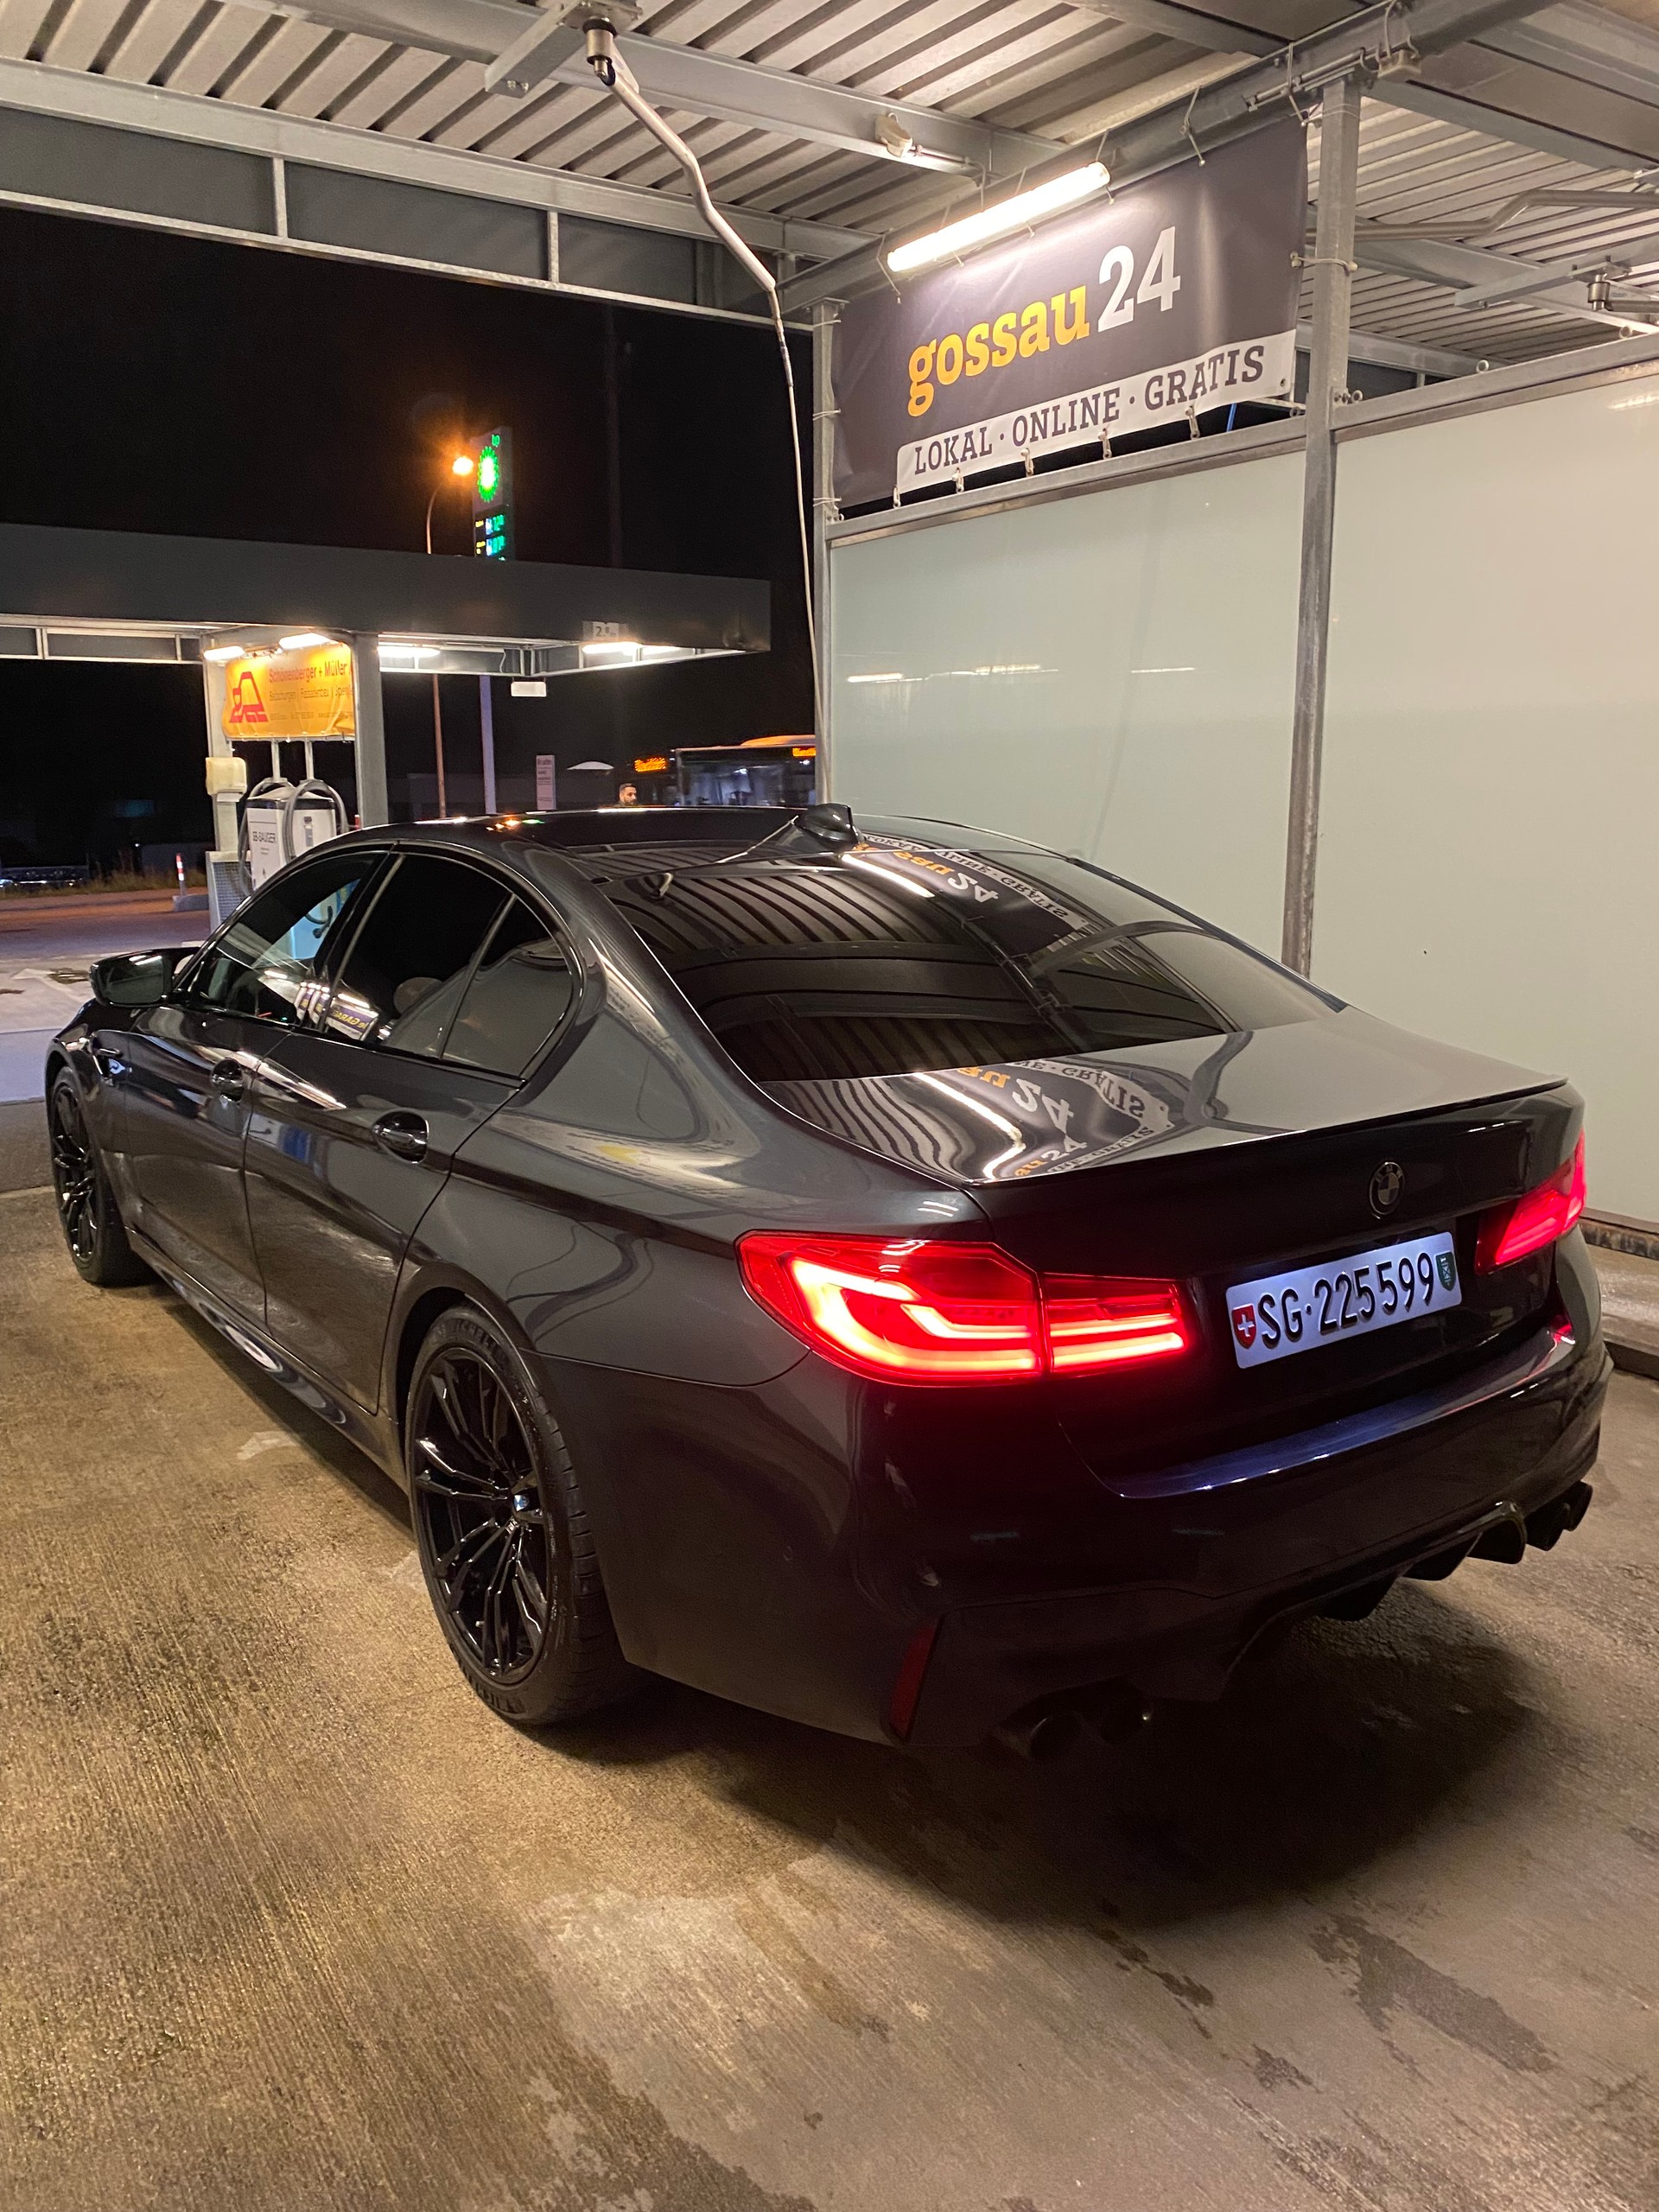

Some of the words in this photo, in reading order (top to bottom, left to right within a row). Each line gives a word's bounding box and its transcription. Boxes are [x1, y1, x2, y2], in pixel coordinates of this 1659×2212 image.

[914, 427, 992, 475] LOKAL
[1013, 388, 1120, 447] ONLINE
[1144, 346, 1264, 411] GRATIS
